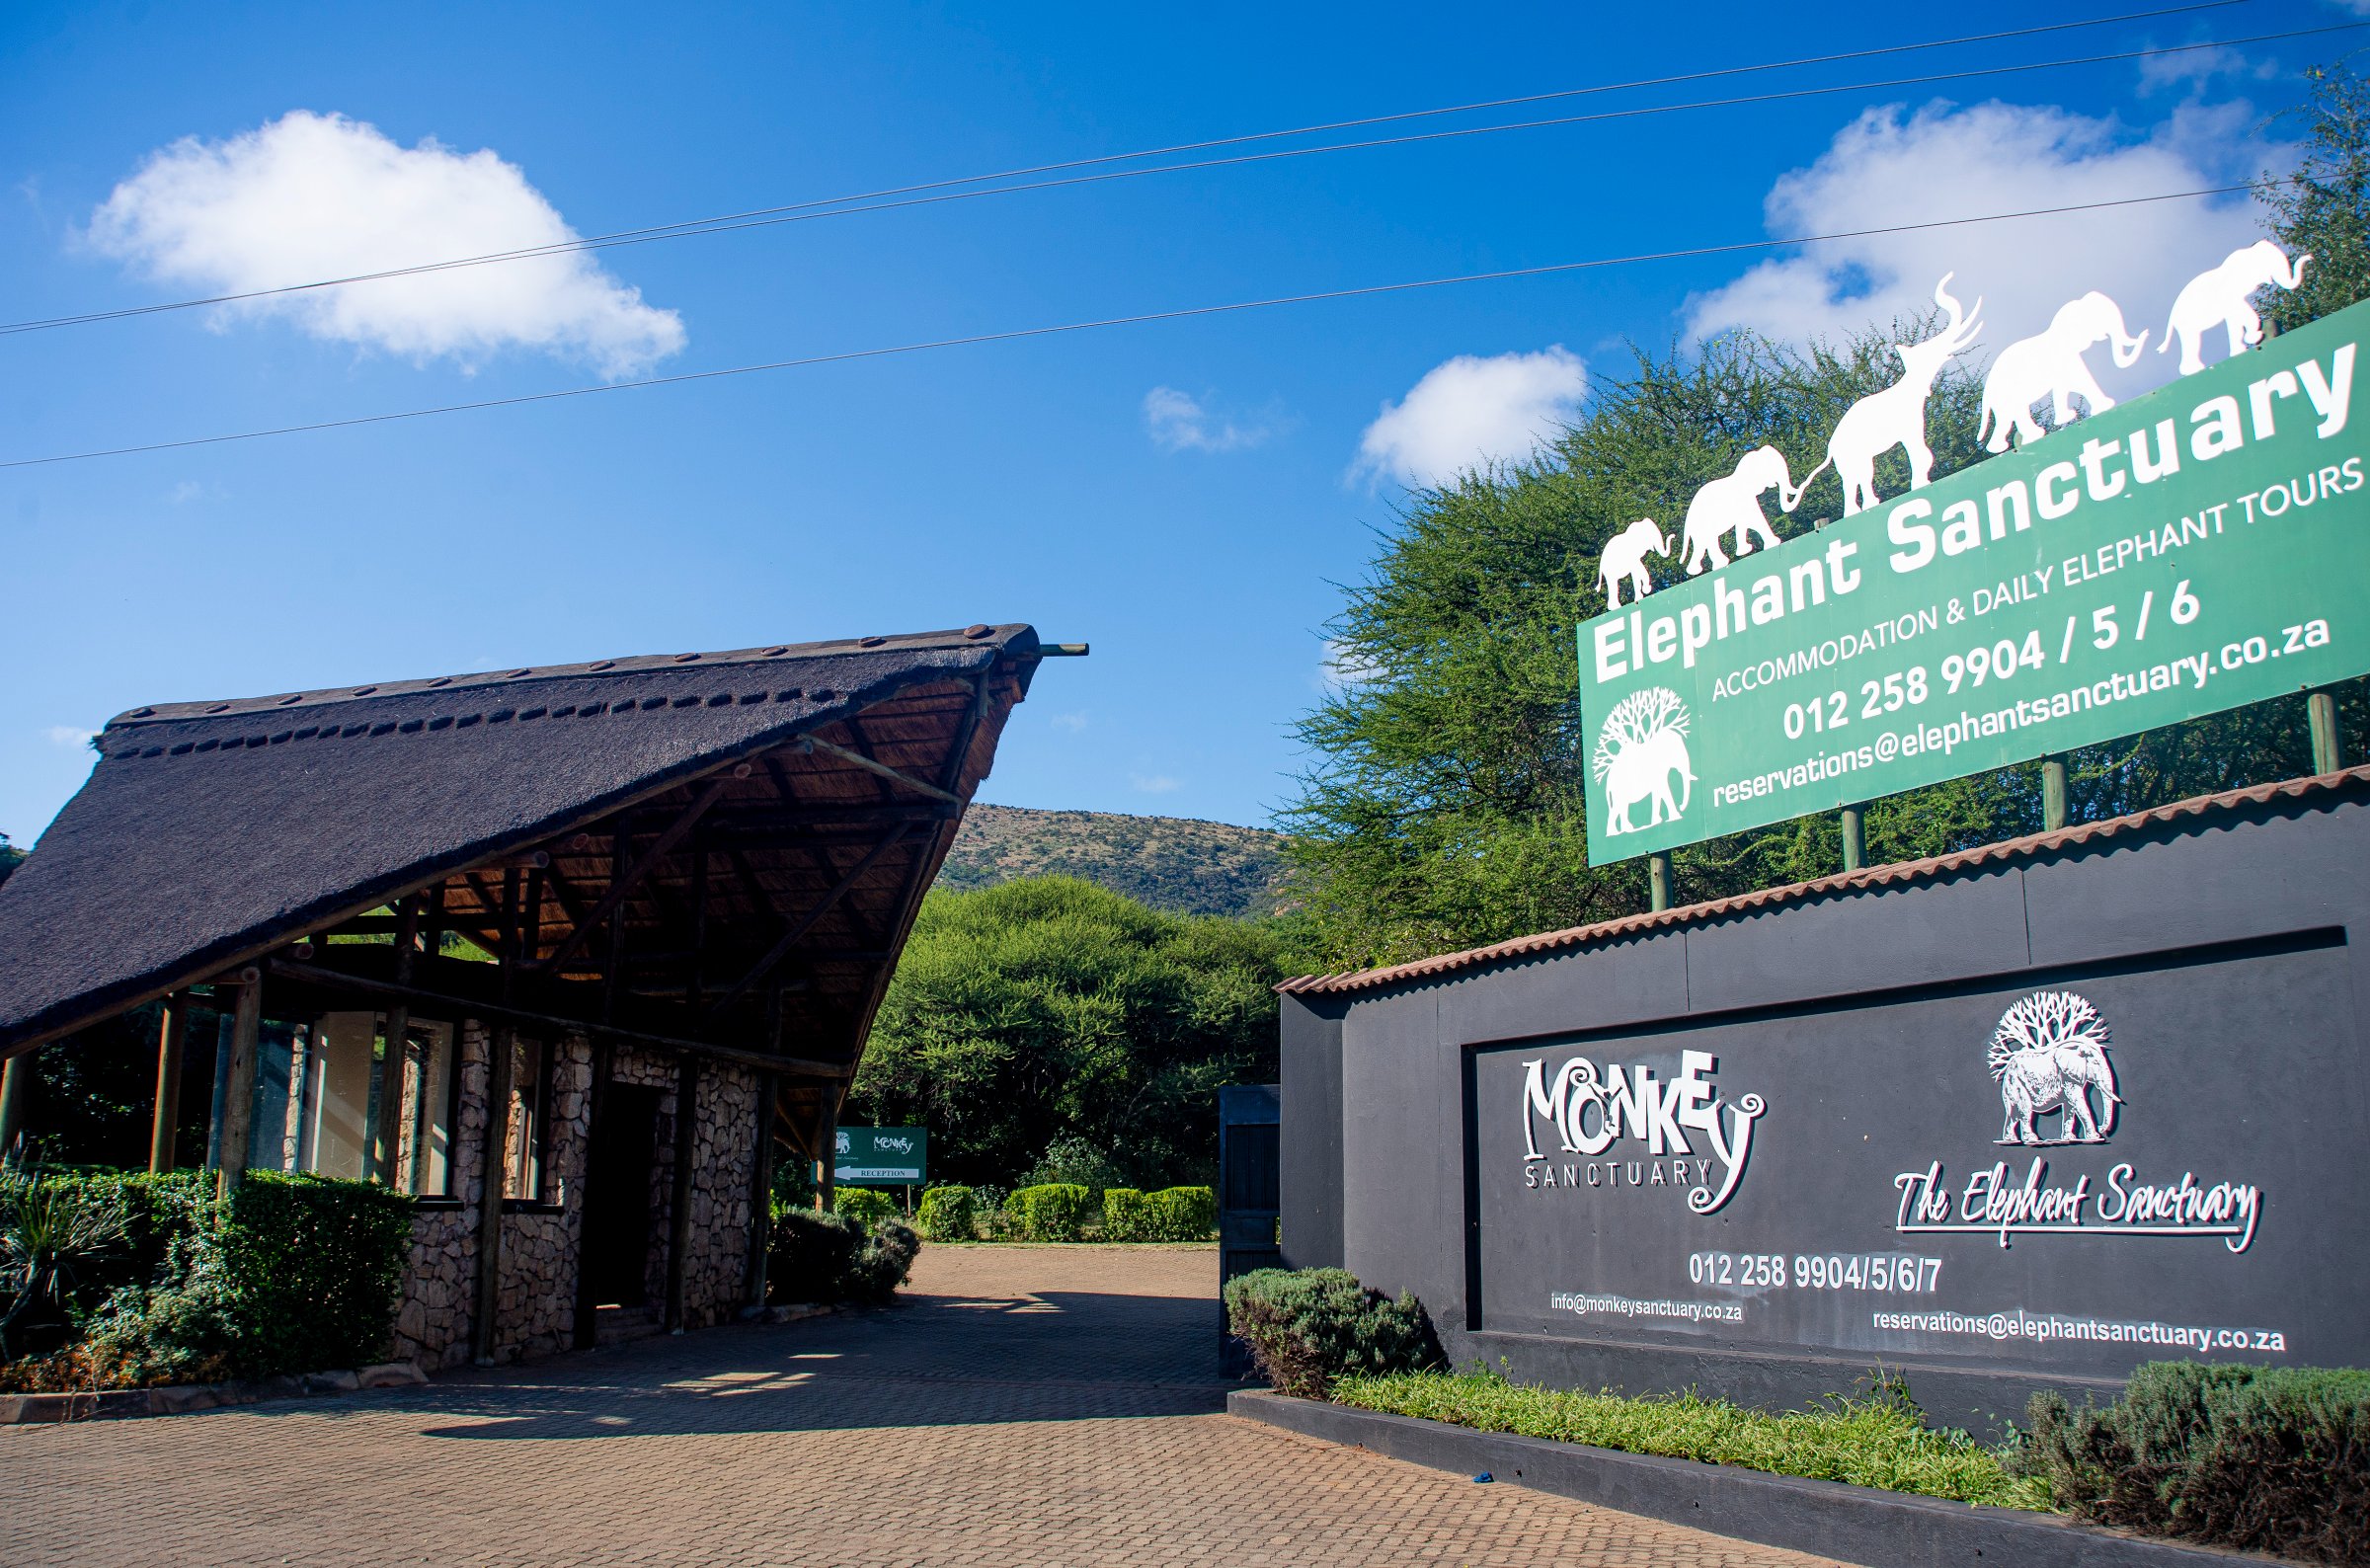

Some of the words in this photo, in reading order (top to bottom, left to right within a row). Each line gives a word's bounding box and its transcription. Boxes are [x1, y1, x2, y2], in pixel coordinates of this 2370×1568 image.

[1594, 541, 1861, 684] Elephant
[1886, 343, 2357, 576] Sanctuary
[1711, 606, 1938, 702] ACCOMMODATION
[1944, 598, 1965, 622] &
[1973, 566, 2055, 618] DAILY
[2063, 503, 2229, 587] ELEPHANT
[2237, 457, 2363, 524] TOURS
[1782, 689, 1849, 740] 012
[1861, 667, 1930, 719] 258
[1939, 631, 2044, 696] 9904
[2059, 616, 2077, 665] /
[2093, 605, 2118, 649] 5
[2133, 590, 2153, 641] /
[2171, 579, 2200, 626] 6
[1713, 618, 2330, 810] reservations@elephantsanctuary.co.za
[1525, 1159, 1713, 1189] SANCTUARY
[1894, 1160, 1951, 1227] The
[1961, 1156, 2091, 1247] Elephant
[2097, 1163, 2258, 1252] Sanctuary
[1550, 1294, 1743, 1321] info@monkeysanctuary.co.za
[1689, 1253, 1734, 1284] 012
[1740, 1255, 1786, 1287] 258
[1794, 1256, 1942, 1292] 9904/5/6/7
[1872, 1310, 2286, 1352] reservations@elephantsanctuary.co.za
